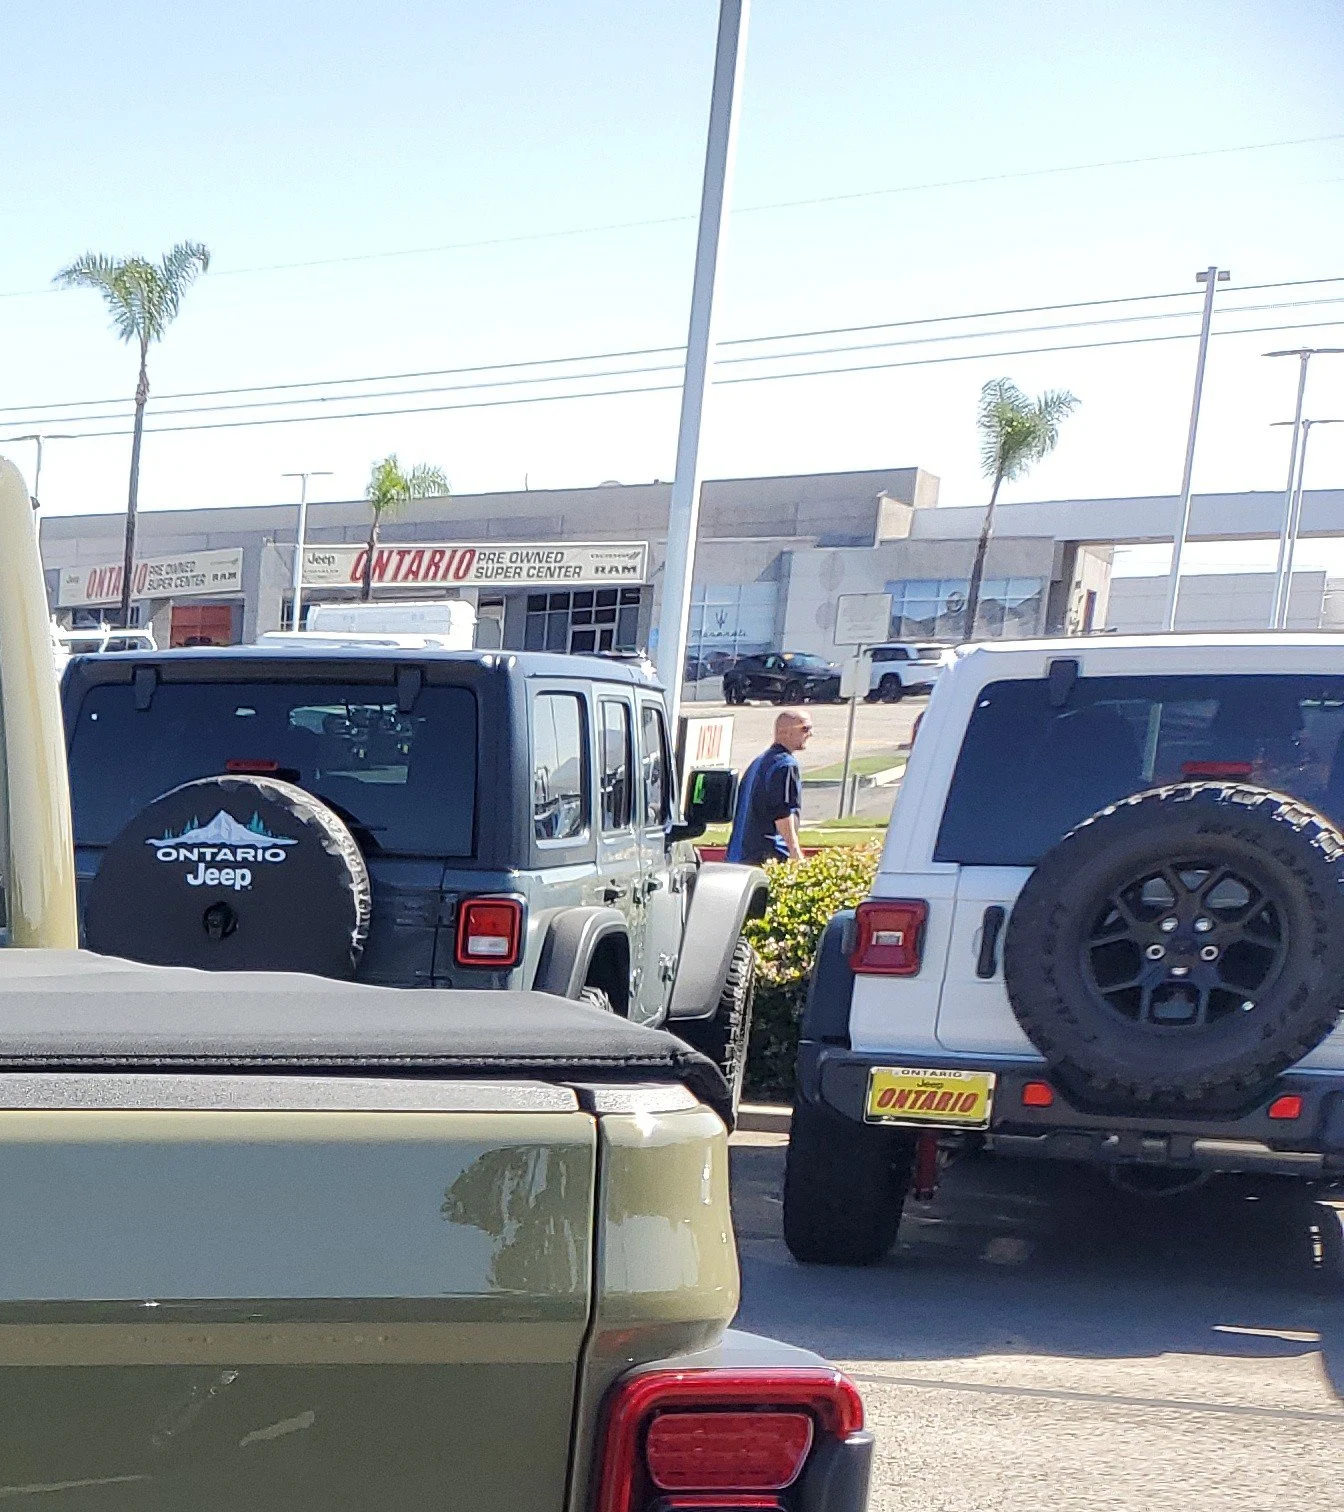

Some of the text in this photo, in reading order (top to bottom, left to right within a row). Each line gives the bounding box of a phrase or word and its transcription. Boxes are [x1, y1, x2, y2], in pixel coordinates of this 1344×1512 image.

[307, 553, 336, 566] Jeep
[477, 551, 565, 564] PRE OWNED
[350, 549, 476, 582] ONTARIO
[474, 565, 583, 579] SUPER CENTER
[594, 565, 637, 575] RAM
[86, 563, 149, 599] ONTAIO
[212, 572, 237, 582] RAM
[156, 847, 287, 862] ONTARIO
[186, 863, 252, 890] Jeep
[901, 1069, 963, 1078] ONTARIO
[916, 1079, 944, 1089] Jeep
[876, 1088, 980, 1113] ONTARIO
